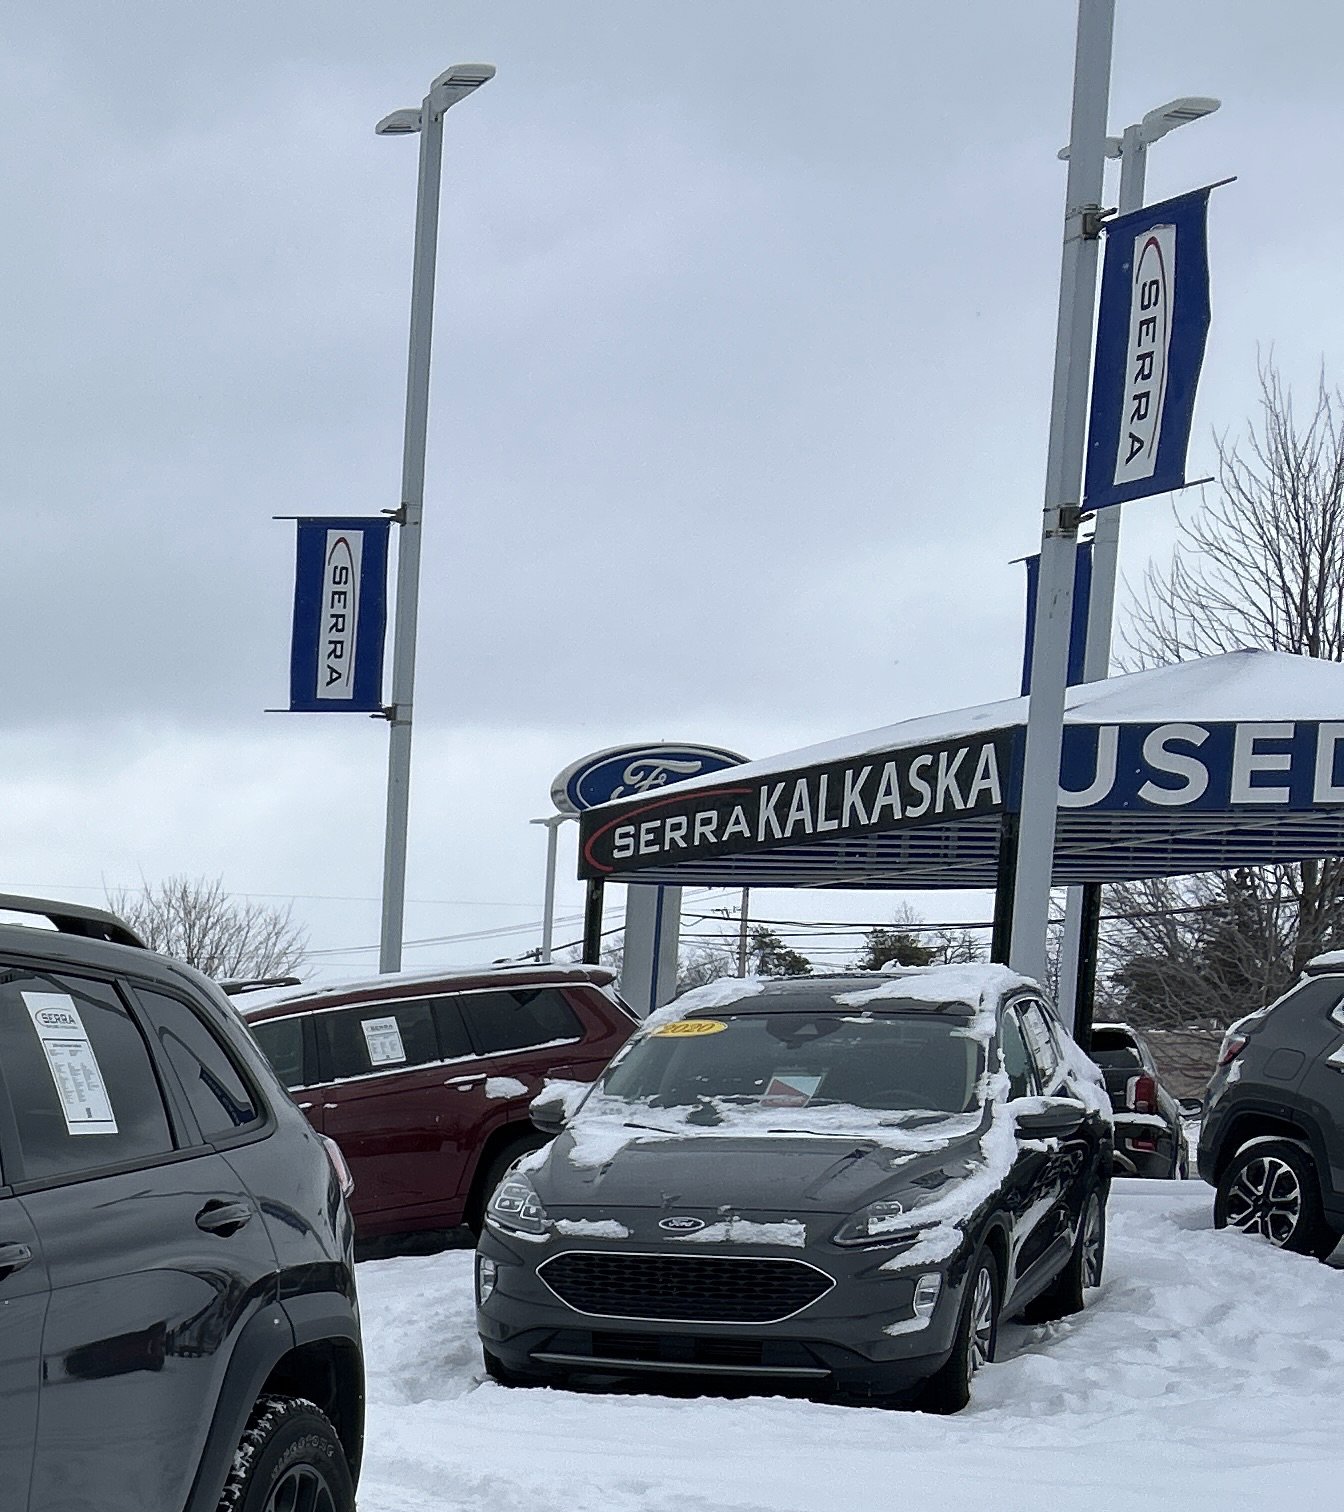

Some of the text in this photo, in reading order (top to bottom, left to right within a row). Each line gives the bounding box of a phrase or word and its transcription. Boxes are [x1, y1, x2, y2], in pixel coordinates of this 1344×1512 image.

[1124, 278, 1161, 465] SERRA
[325, 565, 349, 687] SERRA
[612, 804, 762, 859] SERRA
[756, 742, 1003, 842] KALKASKA
[41, 1012, 77, 1025] SERRA
